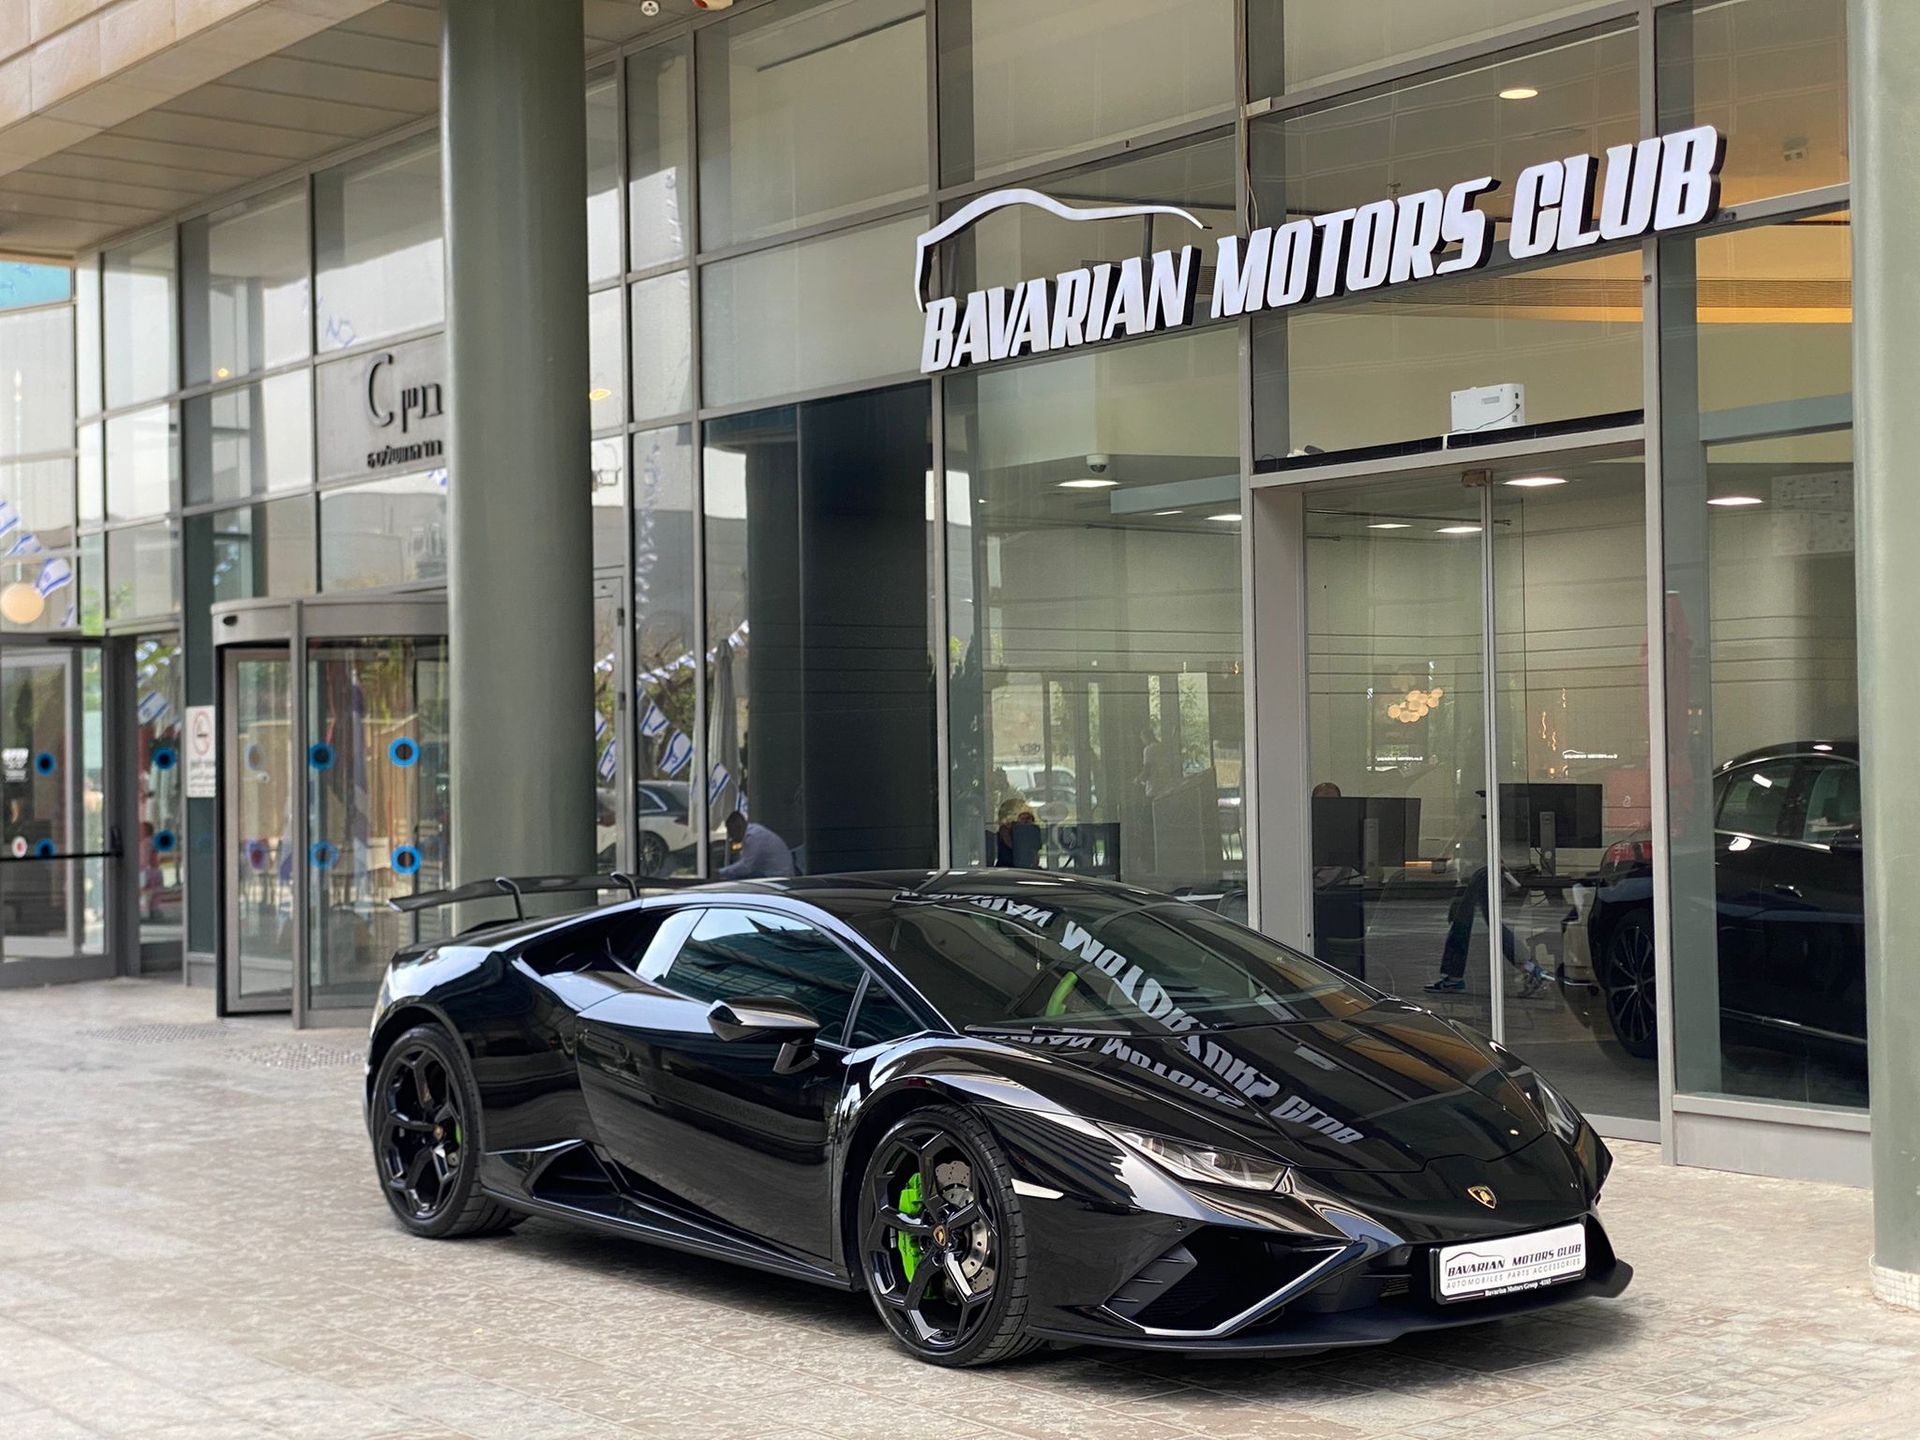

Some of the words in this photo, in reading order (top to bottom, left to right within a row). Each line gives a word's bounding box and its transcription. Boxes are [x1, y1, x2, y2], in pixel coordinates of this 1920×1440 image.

[920, 245, 1201, 373] BAVARIAN
[1211, 176, 1500, 318] MOTORS
[1508, 125, 1726, 259] CLUB
[362, 352, 394, 428] C
[1446, 1274, 1504, 1290] AUTOMOBILES
[1507, 1269, 1530, 1280] PARTS
[1533, 1257, 1581, 1274] ACCESSORIES
[1447, 1259, 1506, 1277] BAVARIAN
[1511, 1250, 1554, 1267] MOTORS
[1557, 1243, 1582, 1257] CLUB
